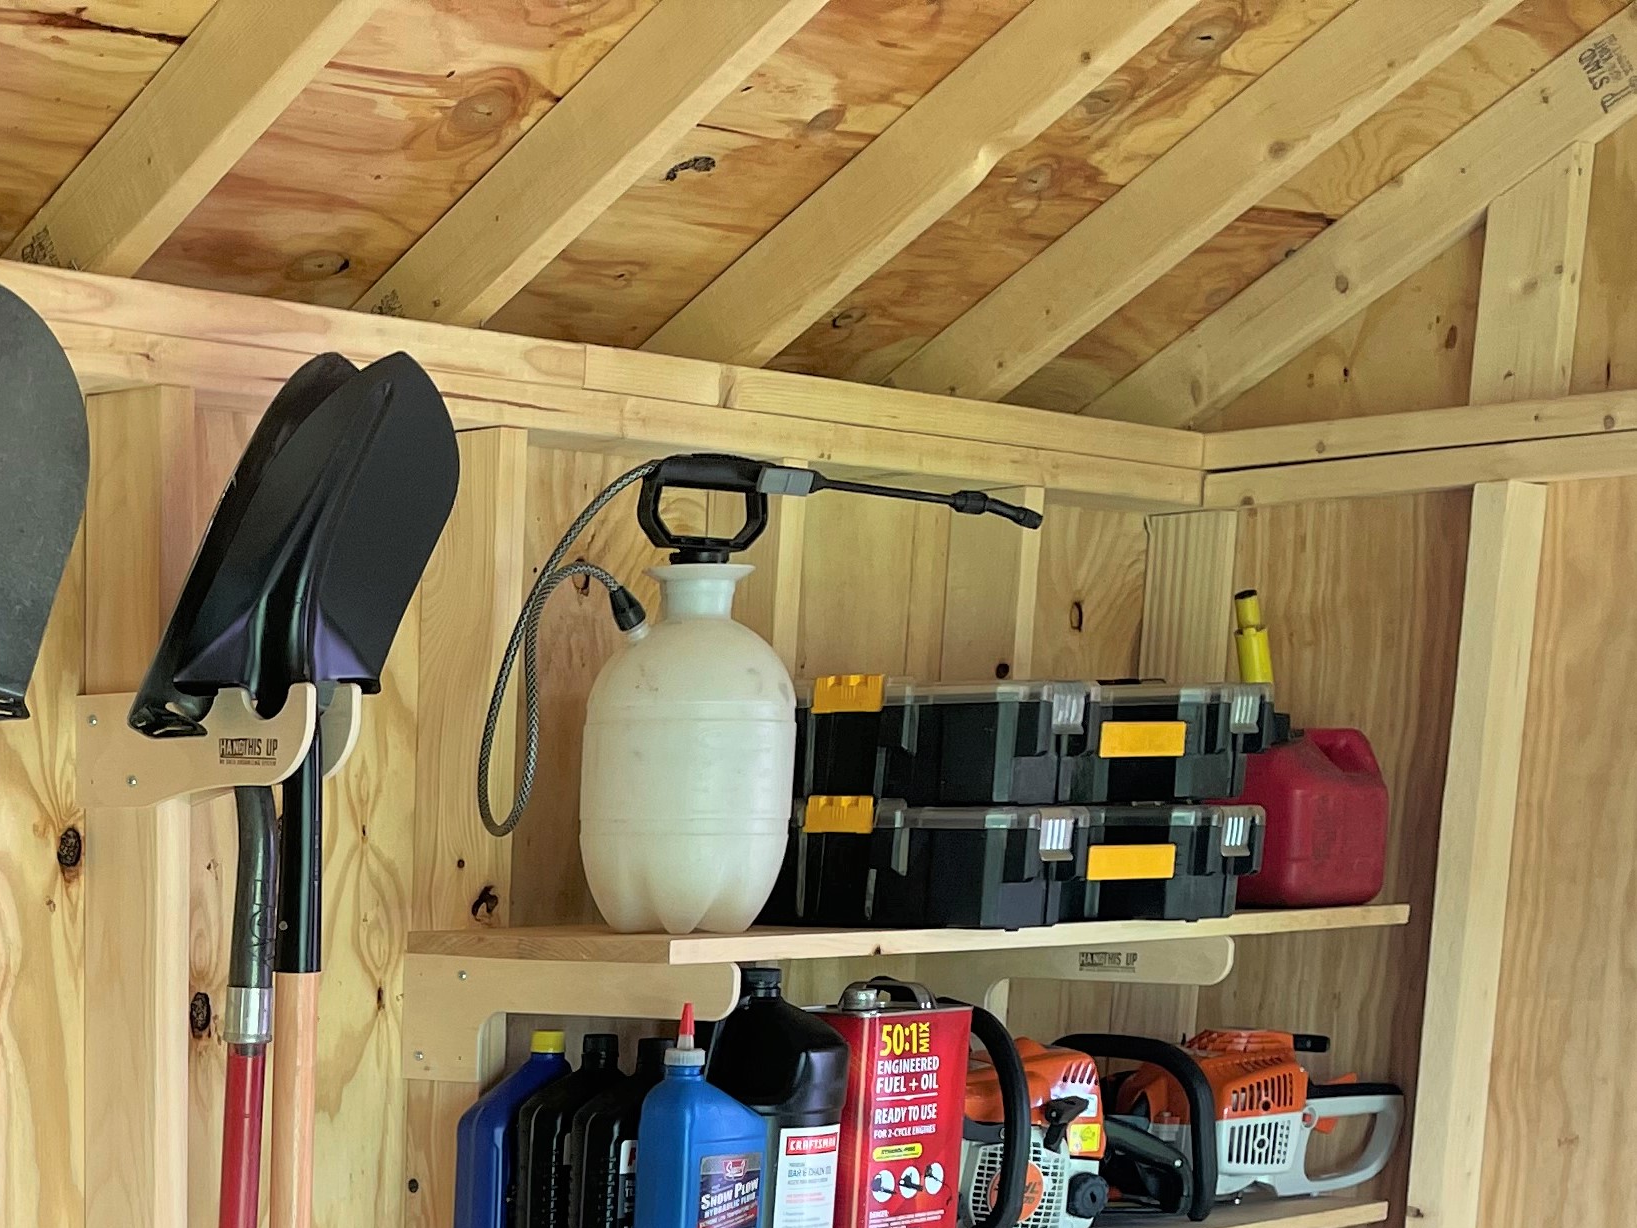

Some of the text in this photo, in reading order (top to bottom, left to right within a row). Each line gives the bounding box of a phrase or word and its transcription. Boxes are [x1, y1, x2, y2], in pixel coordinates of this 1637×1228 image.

[266, 738, 278, 756] UP
[1126, 952, 1137, 966] UP
[879, 1021, 930, 1057] 50:1 MIX
[877, 1056, 940, 1075] ENGINEERED
[876, 1073, 938, 1094] FUEL + OIL
[874, 1103, 938, 1125] READY TO USE
[874, 1129, 887, 1139] FOR
[887, 1127, 911, 1137] 2-CYCLE
[700, 1177, 759, 1210] SNOW PLOW
